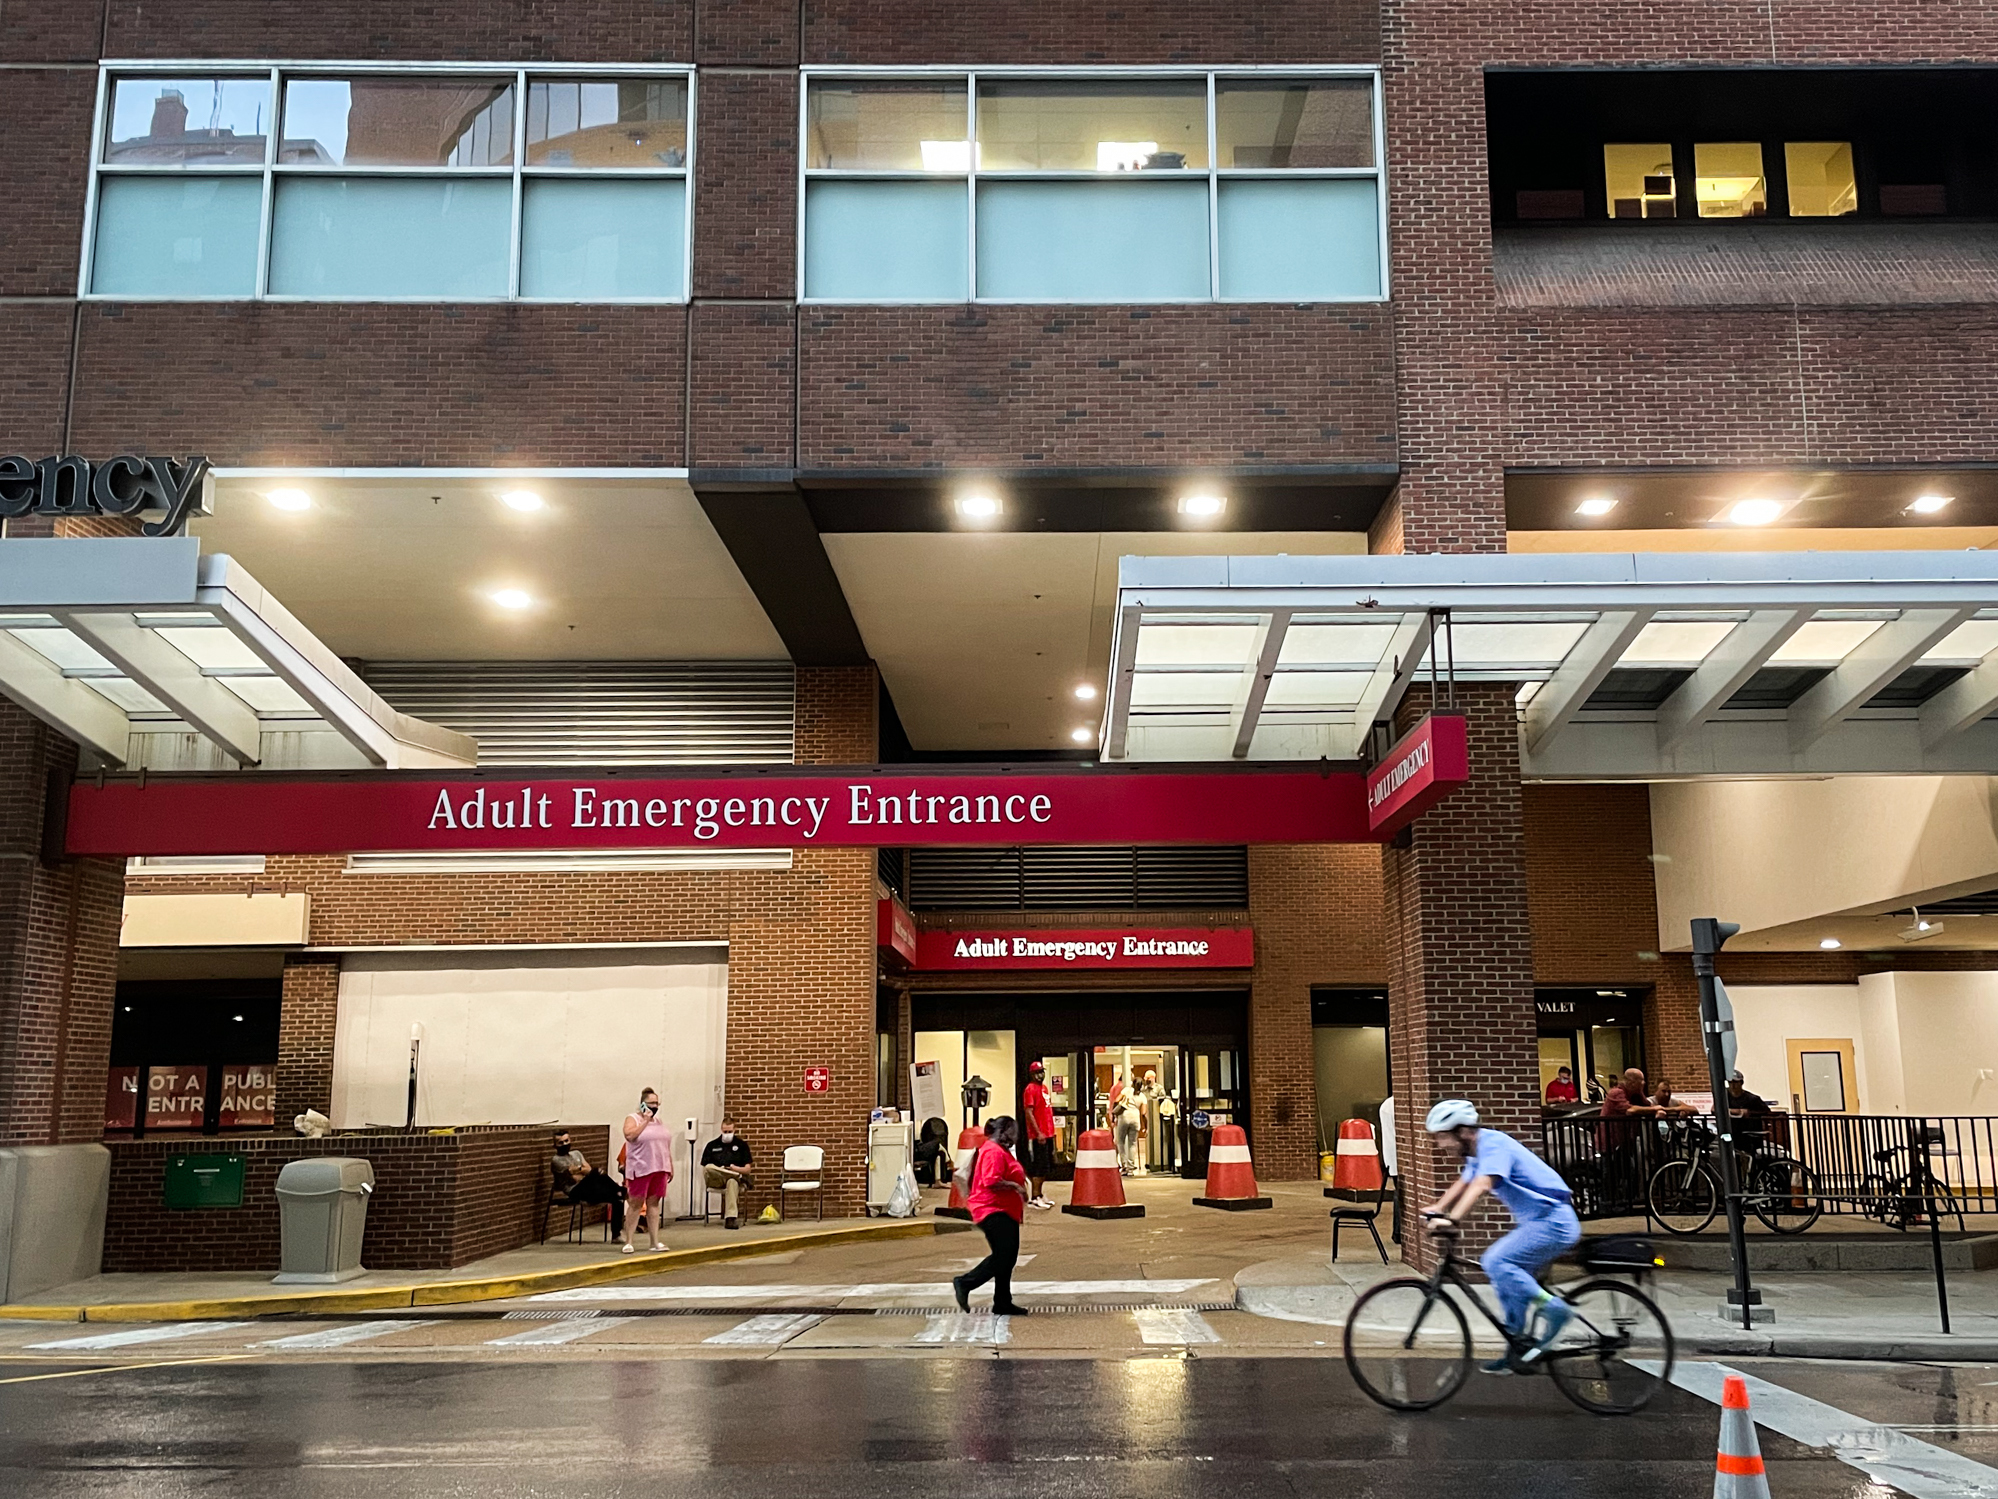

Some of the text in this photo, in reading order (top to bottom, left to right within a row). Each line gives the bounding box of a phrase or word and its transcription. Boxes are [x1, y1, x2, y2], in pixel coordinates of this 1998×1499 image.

[1374, 738, 1429, 807] ADULT EMERGENCY
[427, 785, 1052, 839] Adult Emergency Entrance
[954, 936, 1209, 960] Adult Emergency Entrance
[1536, 1002, 1575, 1013] VALET
[185, 1074, 200, 1090] A
[148, 1094, 276, 1112] ENTRANCE
